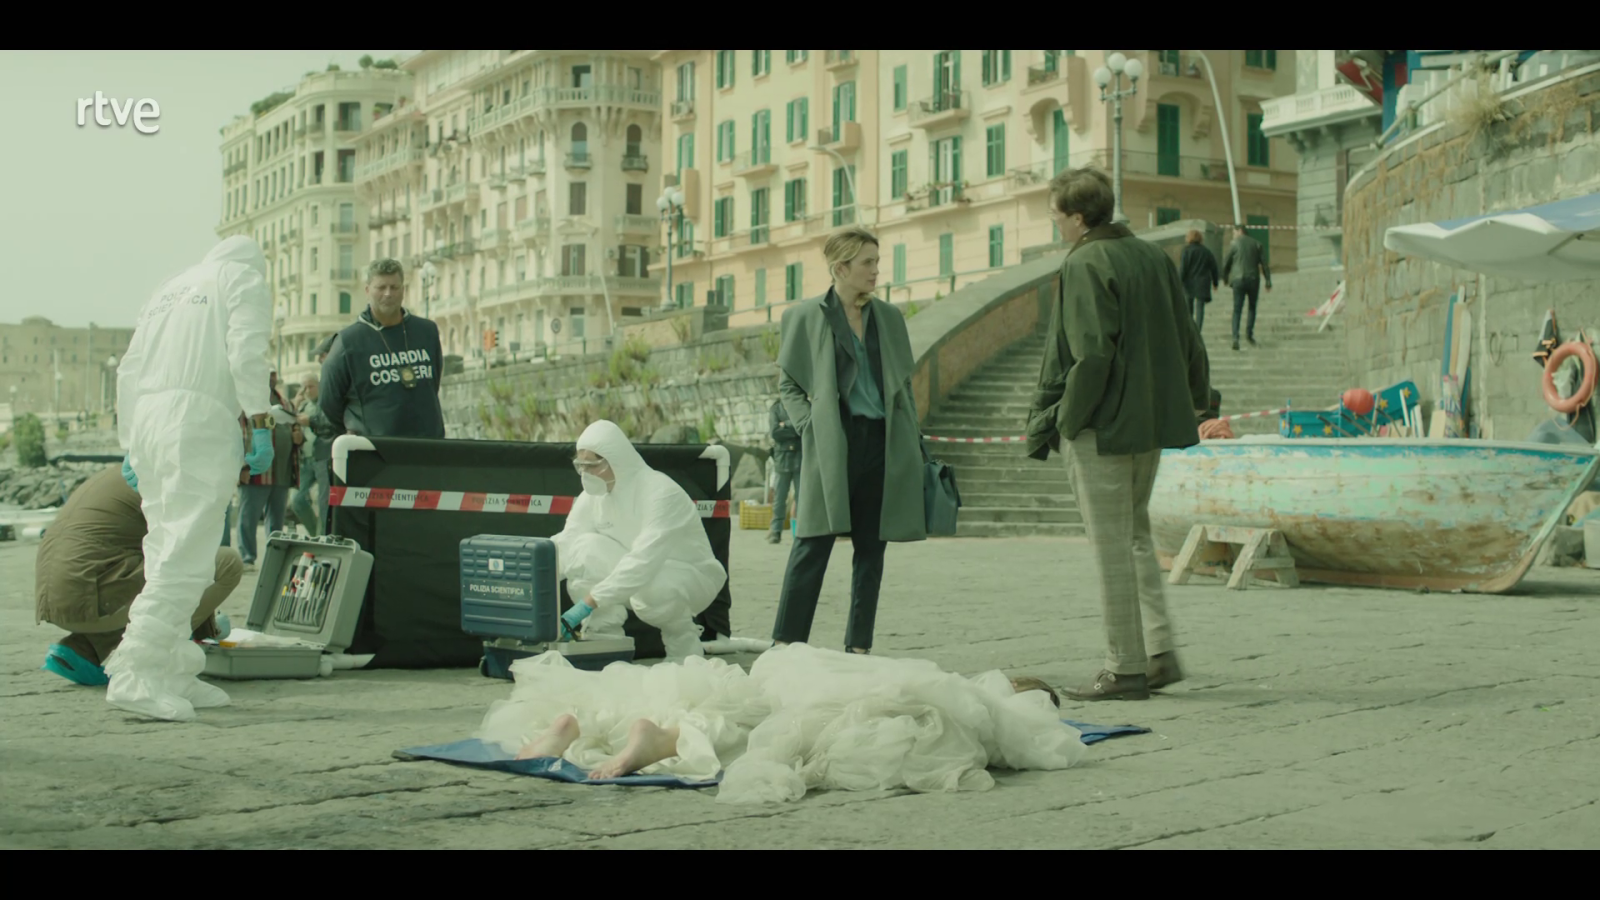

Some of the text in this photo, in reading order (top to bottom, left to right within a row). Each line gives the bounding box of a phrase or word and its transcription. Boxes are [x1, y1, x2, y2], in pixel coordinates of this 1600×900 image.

[369, 349, 431, 369] GUARDIA
[354, 491, 384, 500] POLIZIA
[469, 584, 525, 596] POLIZIA SCIENTIFICA
